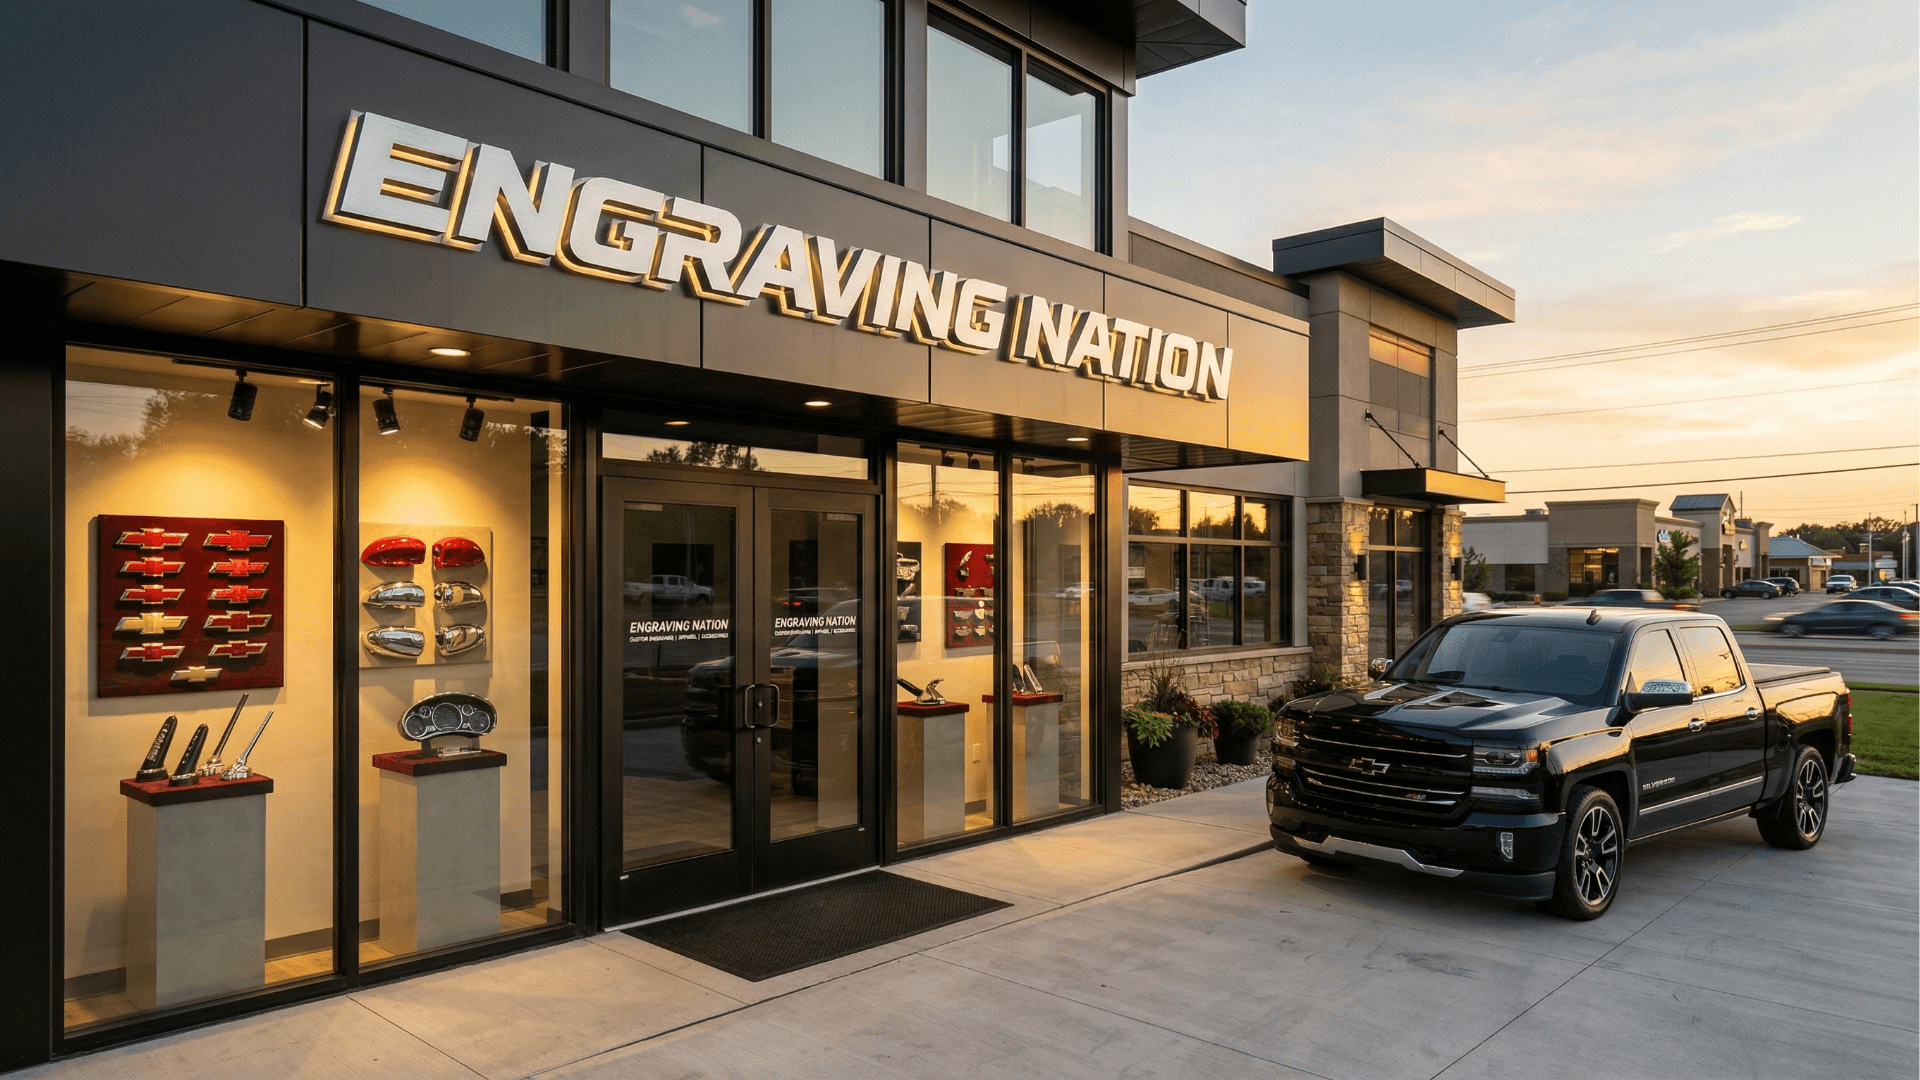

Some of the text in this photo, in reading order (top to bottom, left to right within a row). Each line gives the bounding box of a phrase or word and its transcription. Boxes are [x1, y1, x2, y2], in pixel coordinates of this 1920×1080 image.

[324, 110, 1233, 402] ENGRAVING NATION
[629, 619, 729, 633] ENGRAVING NATION
[774, 615, 857, 628] ENGRAVING NATION
